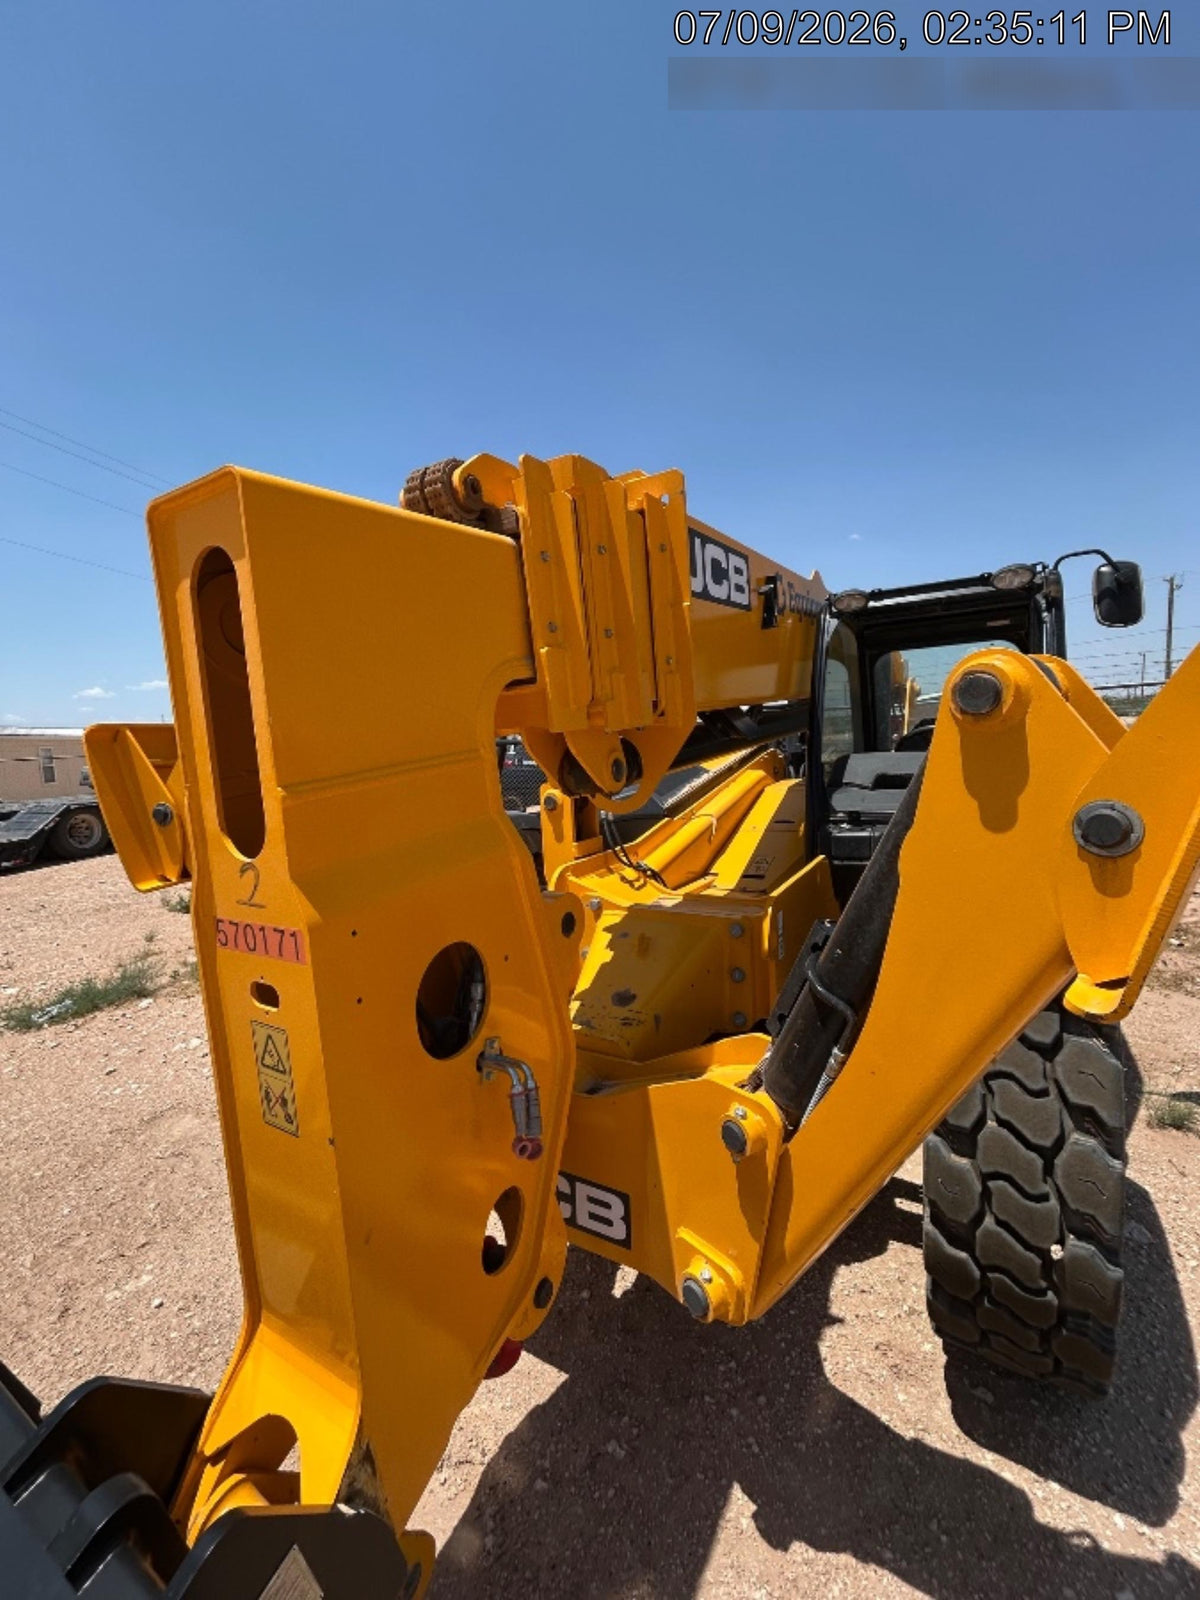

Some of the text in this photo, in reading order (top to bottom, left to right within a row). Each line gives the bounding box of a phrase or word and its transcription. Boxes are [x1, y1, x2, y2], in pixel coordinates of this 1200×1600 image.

[691, 536, 749, 606] JCB
[236, 862, 267, 909] 2
[216, 918, 300, 961] 570171
